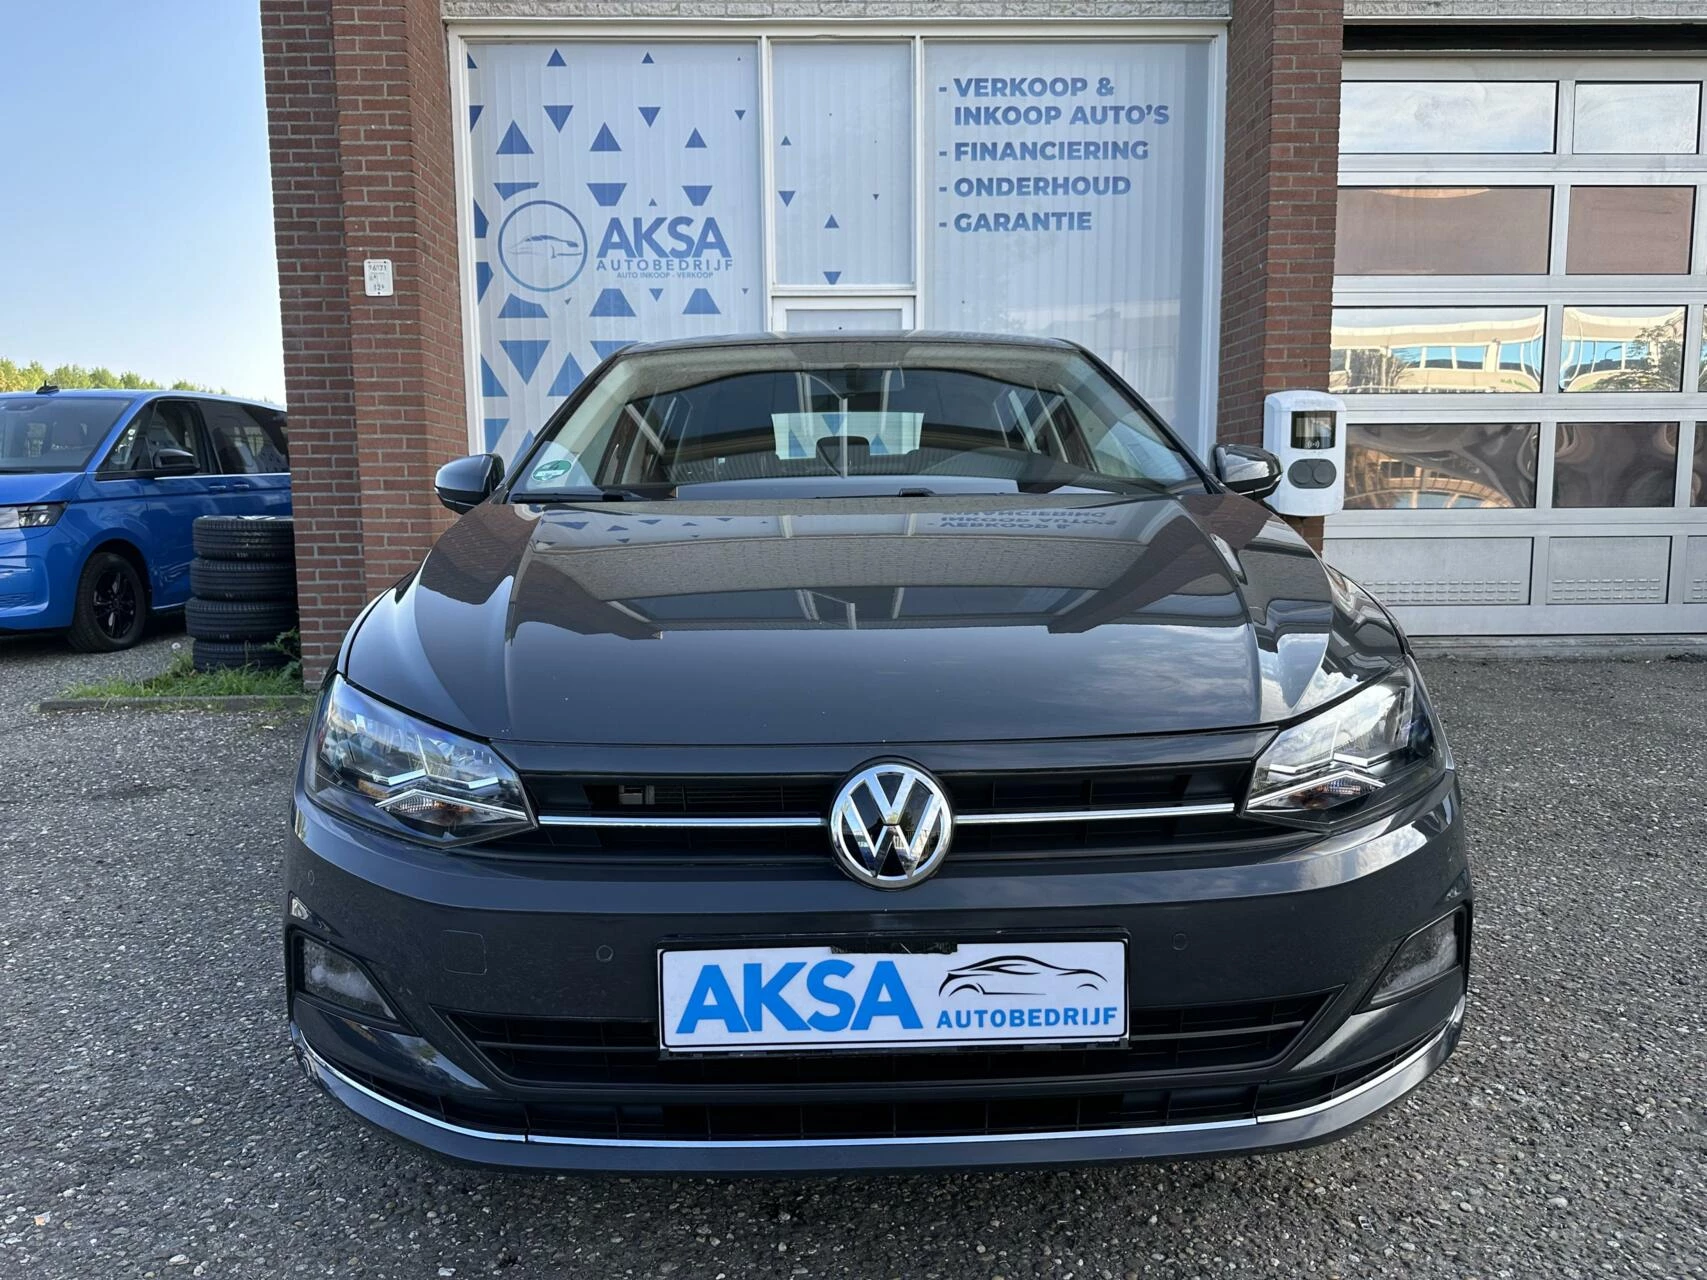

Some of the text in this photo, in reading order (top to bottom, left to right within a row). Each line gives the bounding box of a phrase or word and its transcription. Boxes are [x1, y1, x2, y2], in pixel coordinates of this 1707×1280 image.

[953, 77, 1088, 97] VERKOOP
[1096, 77, 1115, 97] &
[954, 104, 1170, 126] INKOOP AUTO'S
[954, 141, 1149, 162] FINANCIERING
[953, 176, 1132, 198] ONDERHOUD
[953, 212, 1093, 233] GARANTIE
[596, 216, 732, 259] AKSA
[596, 259, 733, 271] AUTOBEDRIJF
[616, 271, 638, 279] AUTO
[640, 271, 671, 279] INKOOP
[677, 271, 714, 279] VERKOOP
[675, 959, 924, 1034] AKSA
[936, 1007, 1118, 1029] AUTOBEDRIJF
